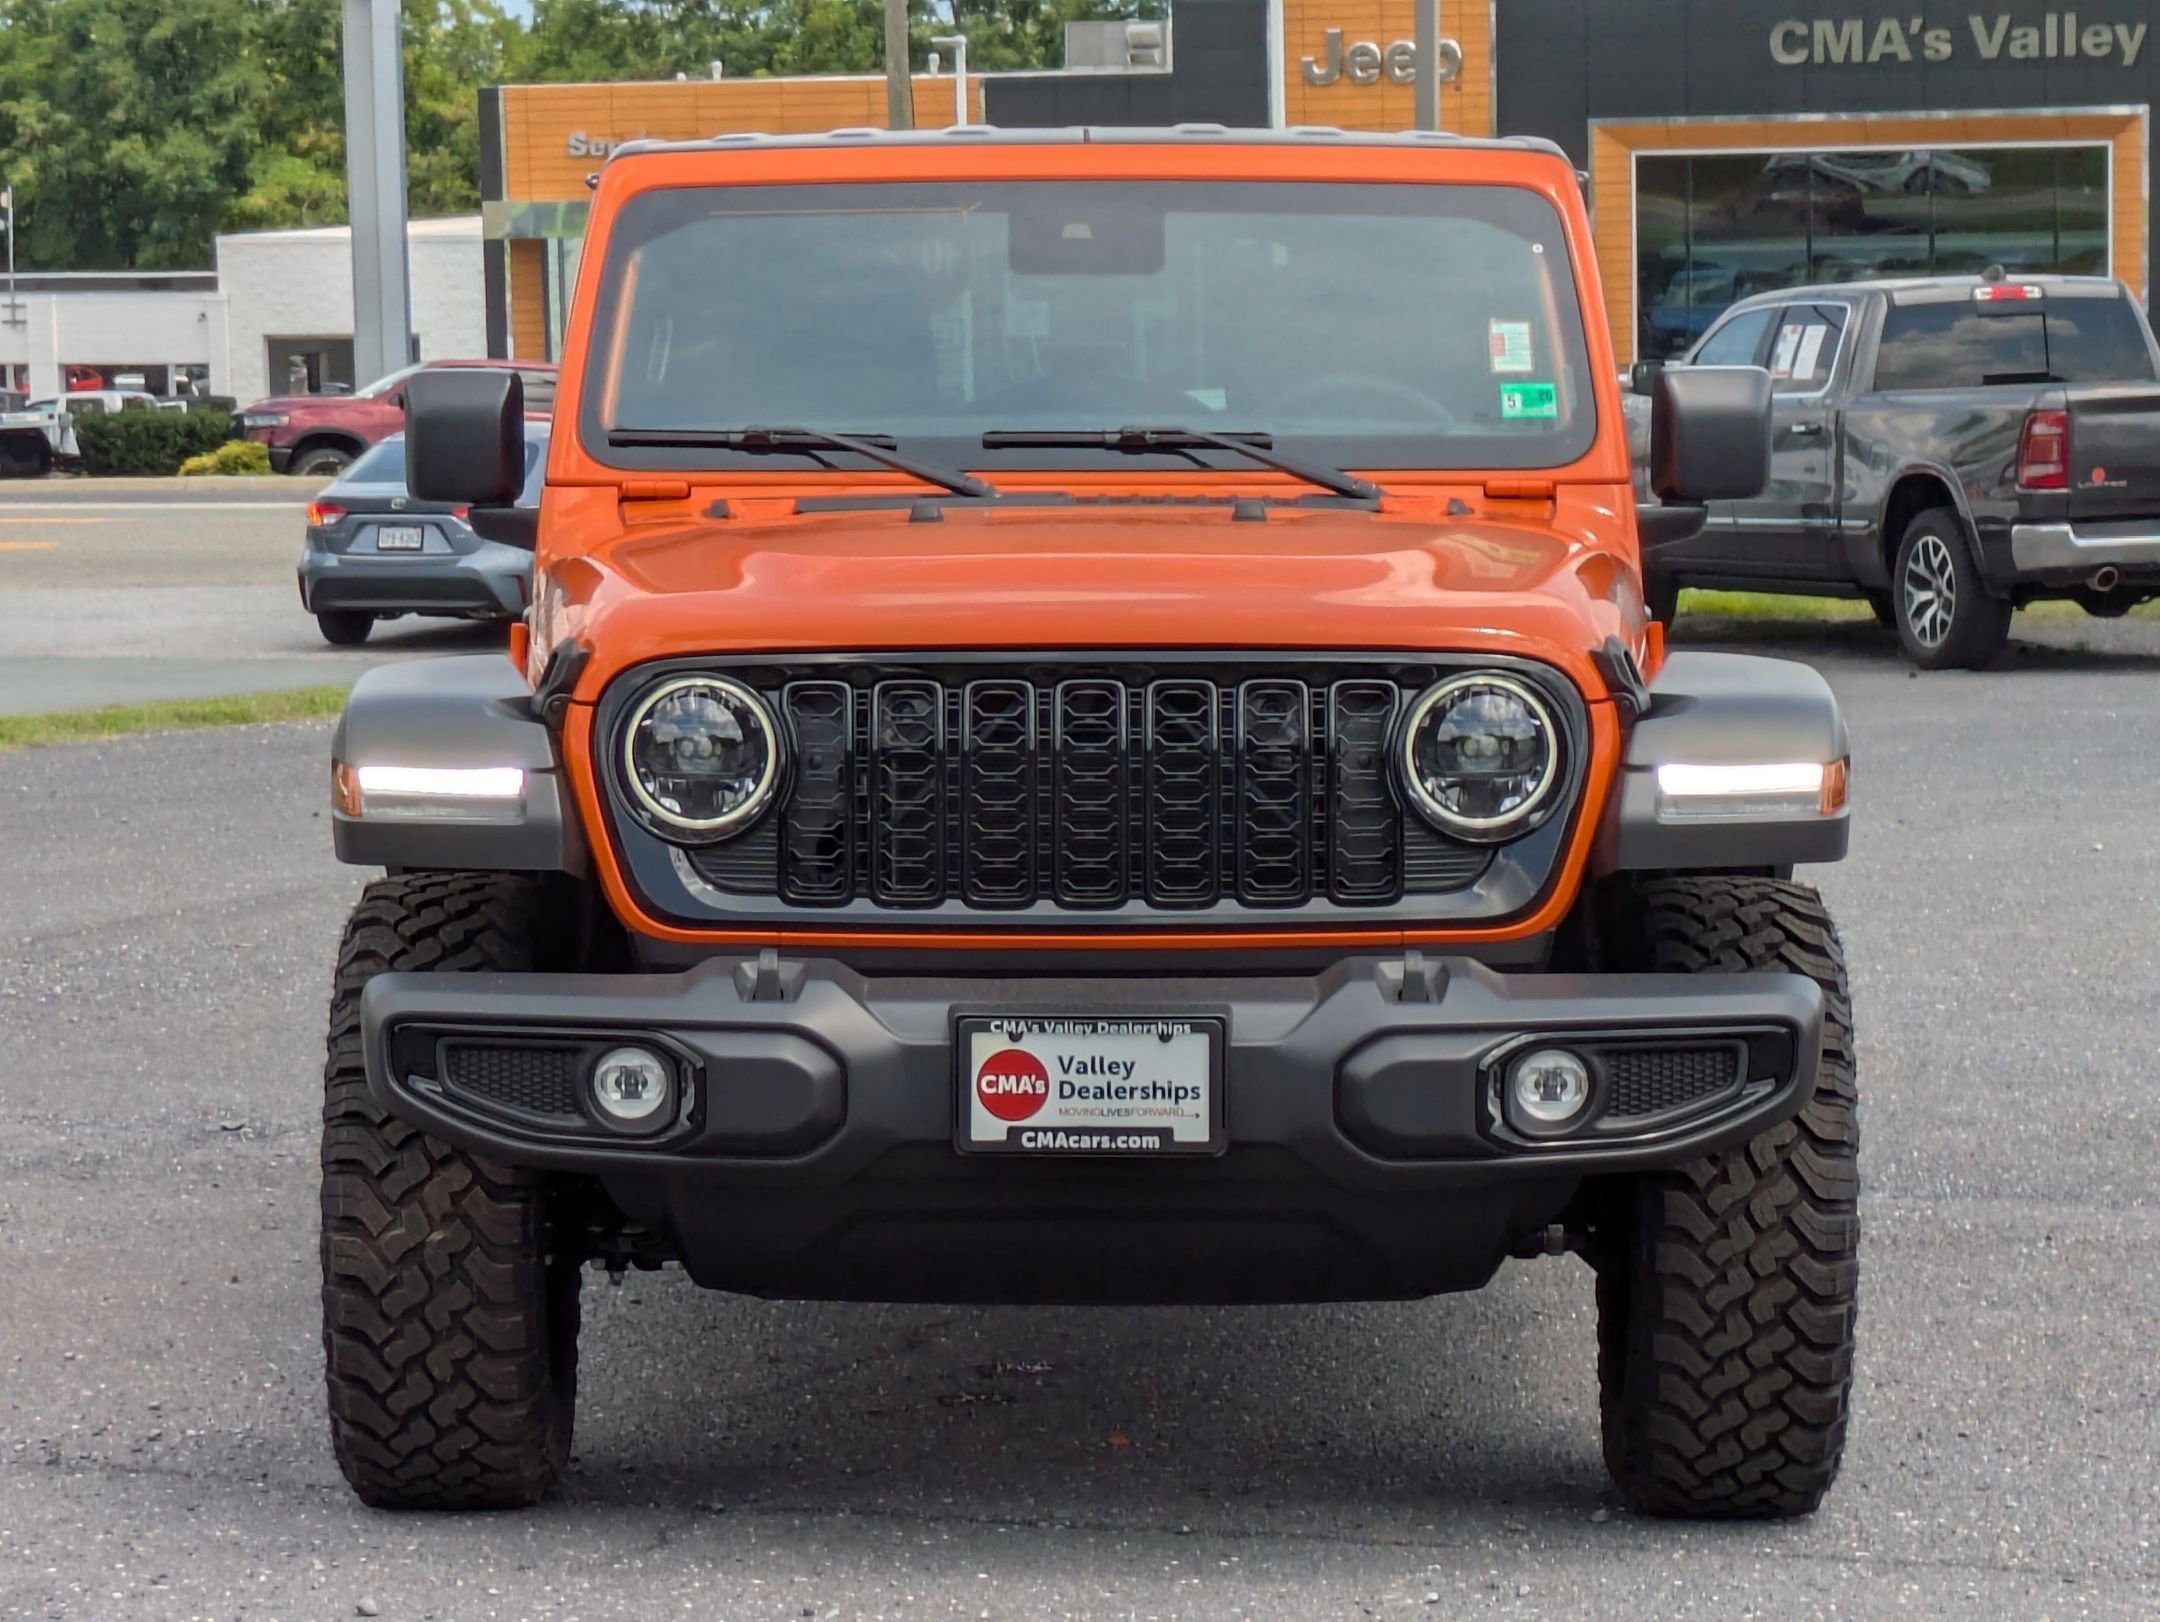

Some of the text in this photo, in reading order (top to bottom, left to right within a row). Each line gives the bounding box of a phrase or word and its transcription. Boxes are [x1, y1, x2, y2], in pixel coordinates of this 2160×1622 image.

[1769, 12, 2147, 66] CMA's Valley
[1507, 394, 1516, 408] 5
[990, 1020, 1191, 1035] CMA's Valley Dealerships
[1058, 1056, 1135, 1080] Valley
[980, 1074, 1046, 1095] CMA's
[1059, 1080, 1201, 1104] Dealerships
[1021, 1131, 1161, 1149] CMAcars.com
